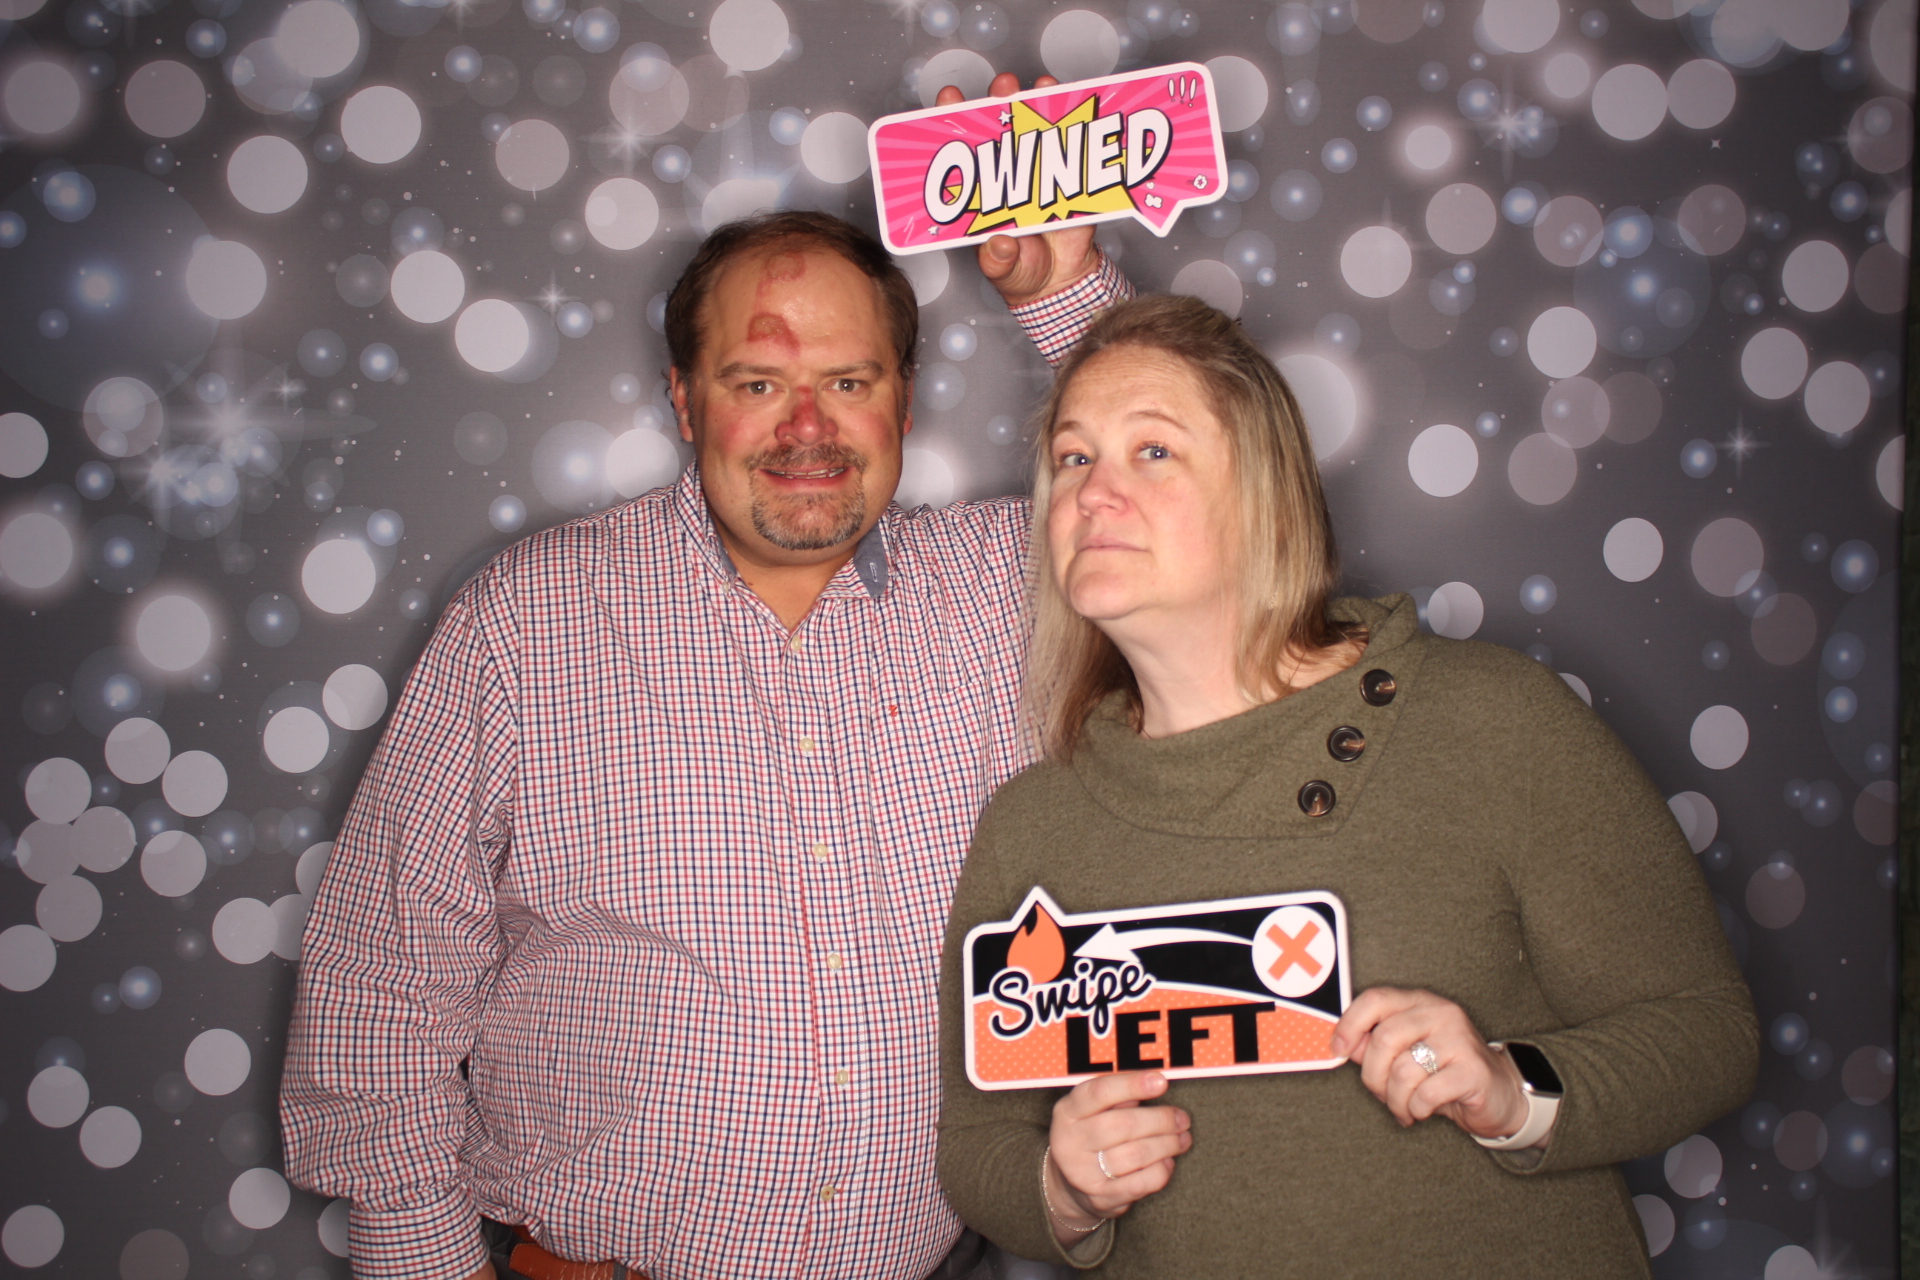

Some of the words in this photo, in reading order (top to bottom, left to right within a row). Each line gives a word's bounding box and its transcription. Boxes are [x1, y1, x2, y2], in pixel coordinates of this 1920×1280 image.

[924, 108, 1172, 224] OWNED
[991, 961, 1153, 1036] Swipe
[1066, 1001, 1276, 1075] LEFT
